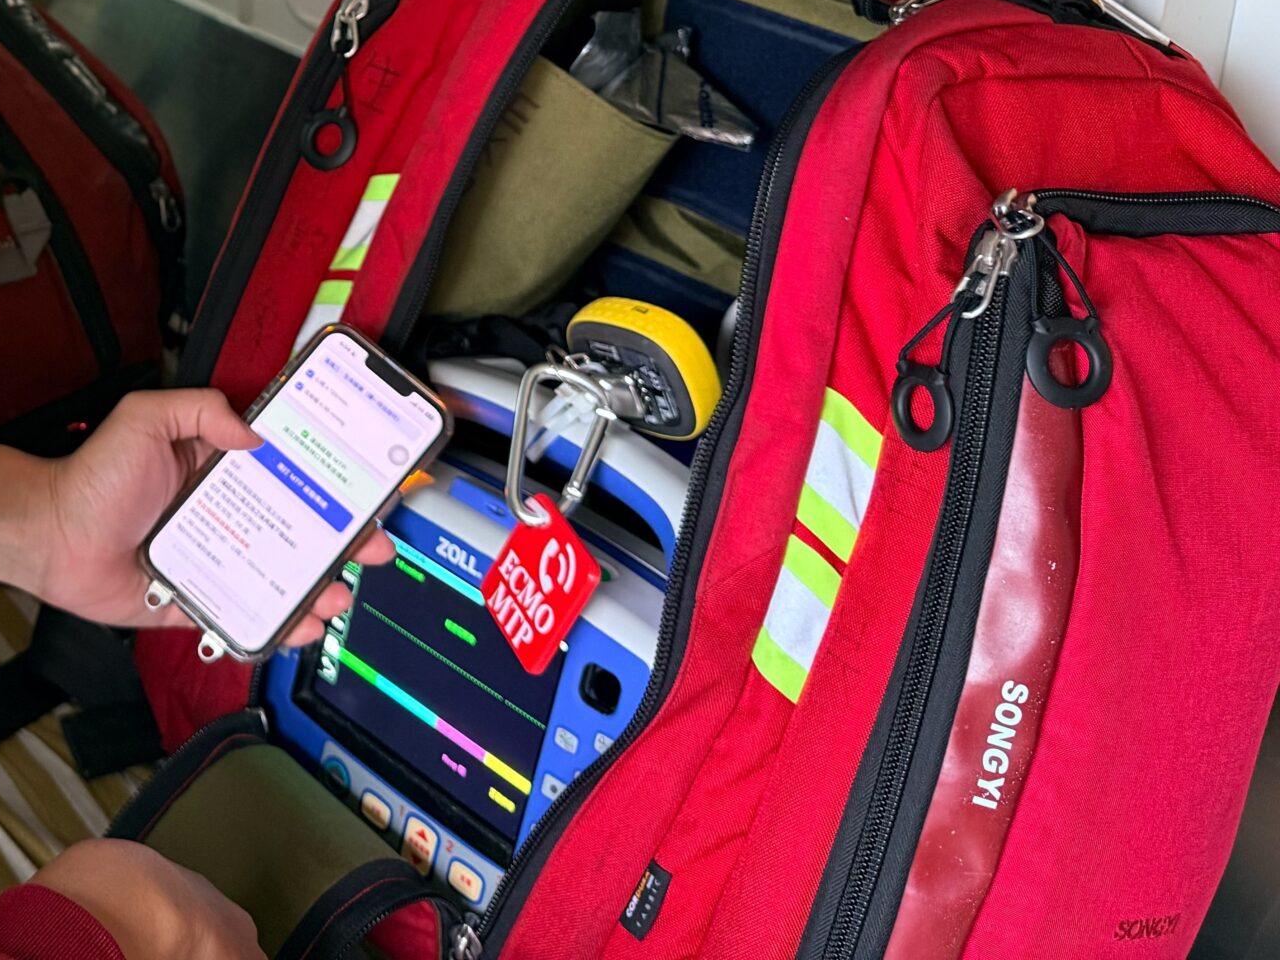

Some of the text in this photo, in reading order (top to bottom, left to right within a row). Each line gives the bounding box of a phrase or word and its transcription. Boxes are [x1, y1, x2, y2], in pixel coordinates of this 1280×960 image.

[435, 536, 478, 577] ZOLL
[487, 583, 534, 650] MTP
[498, 549, 556, 635] ECMO
[972, 679, 1029, 810] SONGYI
[1113, 914, 1178, 941] SONGYI
